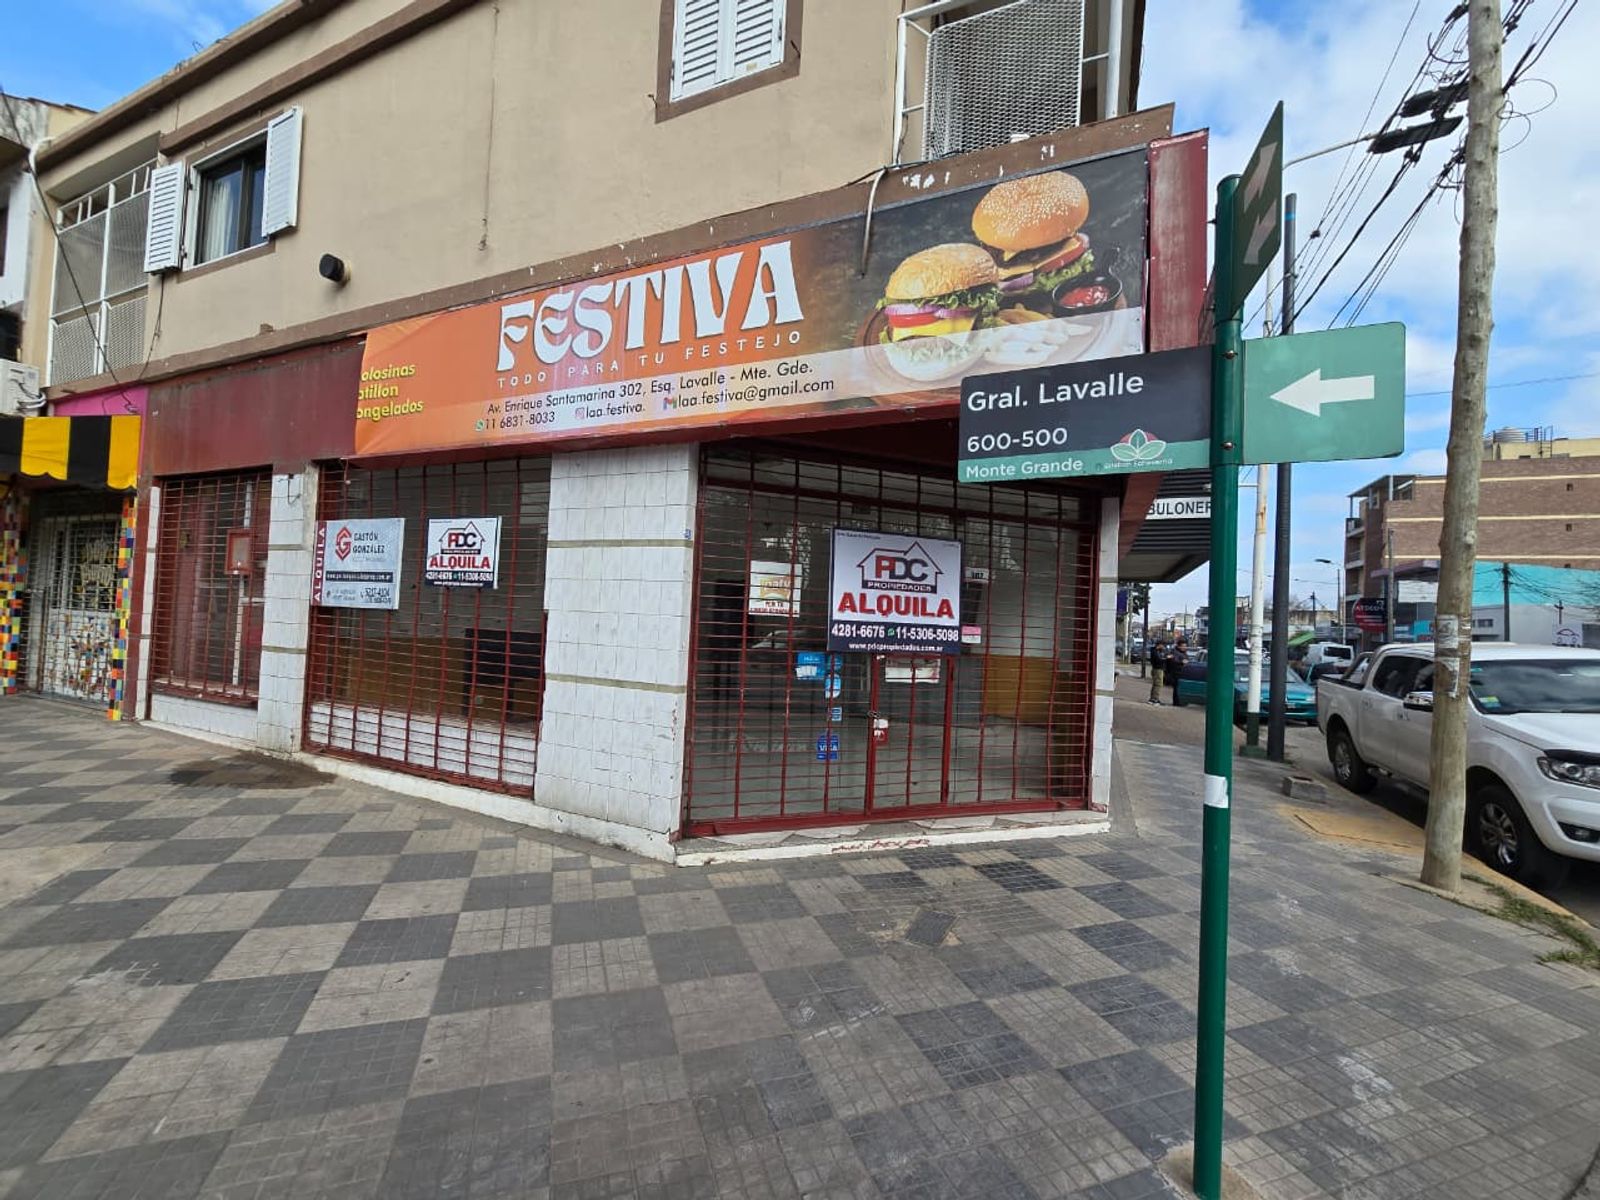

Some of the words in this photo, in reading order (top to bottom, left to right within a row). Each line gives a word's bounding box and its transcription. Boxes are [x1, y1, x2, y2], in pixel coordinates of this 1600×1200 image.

[496, 240, 804, 371] FESTIVA
[497, 371, 546, 388] TODO
[568, 360, 619, 378] PARA
[639, 351, 665, 367] TU
[686, 331, 801, 360] FESTEJO
[488, 403, 501, 414] Av.
[505, 399, 543, 412] Enrique
[546, 388, 615, 406] Santamarina
[619, 382, 647, 398] 302,
[651, 379, 674, 394] Esq.
[680, 372, 725, 389] Lavalle
[740, 367, 771, 381] Mte.
[777, 360, 813, 376] Gde.
[678, 380, 834, 407] laa.festiva@gmail.com
[967, 385, 1028, 411] Gral.
[1039, 373, 1144, 404] Lavalle
[500, 412, 555, 428] 6831-8033
[967, 427, 1068, 453] 600-500
[966, 463, 1015, 478] Monte
[1021, 458, 1083, 474] Grande
[448, 532, 477, 548] PDC
[314, 528, 325, 601] ALQUILA
[430, 556, 491, 569] ALQUILA
[875, 555, 928, 581] PDC
[867, 582, 932, 592] PROPIEDADES
[837, 592, 955, 619] ALQUILA
[831, 623, 885, 638] 4281-6676
[896, 627, 959, 641] 11-5306-5098
